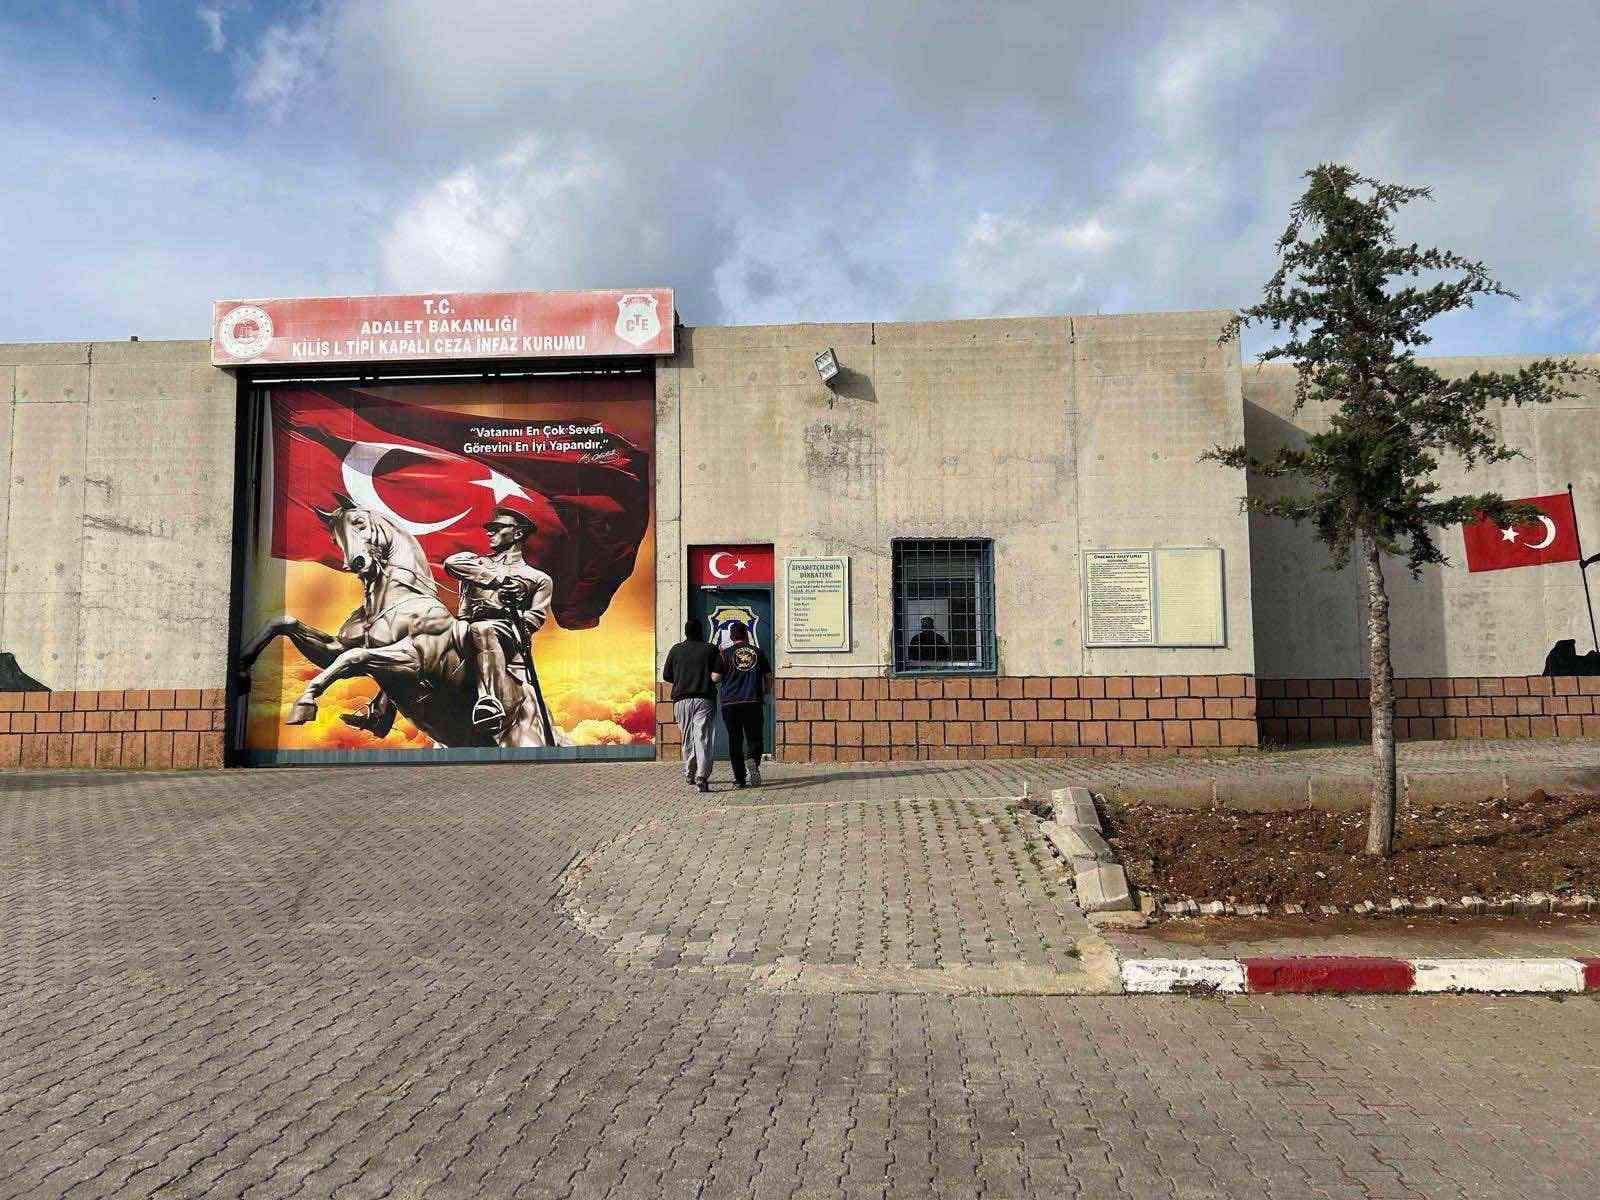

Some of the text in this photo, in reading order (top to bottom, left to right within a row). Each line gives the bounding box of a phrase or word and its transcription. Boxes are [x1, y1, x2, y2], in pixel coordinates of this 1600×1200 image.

[424, 299, 455, 314] T.C.
[361, 316, 518, 334] ADALET BAKANLIĞI
[292, 337, 330, 356] KİLİS
[335, 340, 342, 355] L
[380, 339, 430, 355] KAPALI
[434, 336, 472, 352] CEZA
[477, 335, 518, 352] İNFAZ
[523, 335, 585, 351] KURUMU
[526, 426, 540, 436] En
[543, 425, 565, 438] Çok
[568, 425, 604, 435] Seven
[463, 441, 512, 453] Görevini
[516, 441, 529, 452] En
[532, 439, 546, 455] İyi
